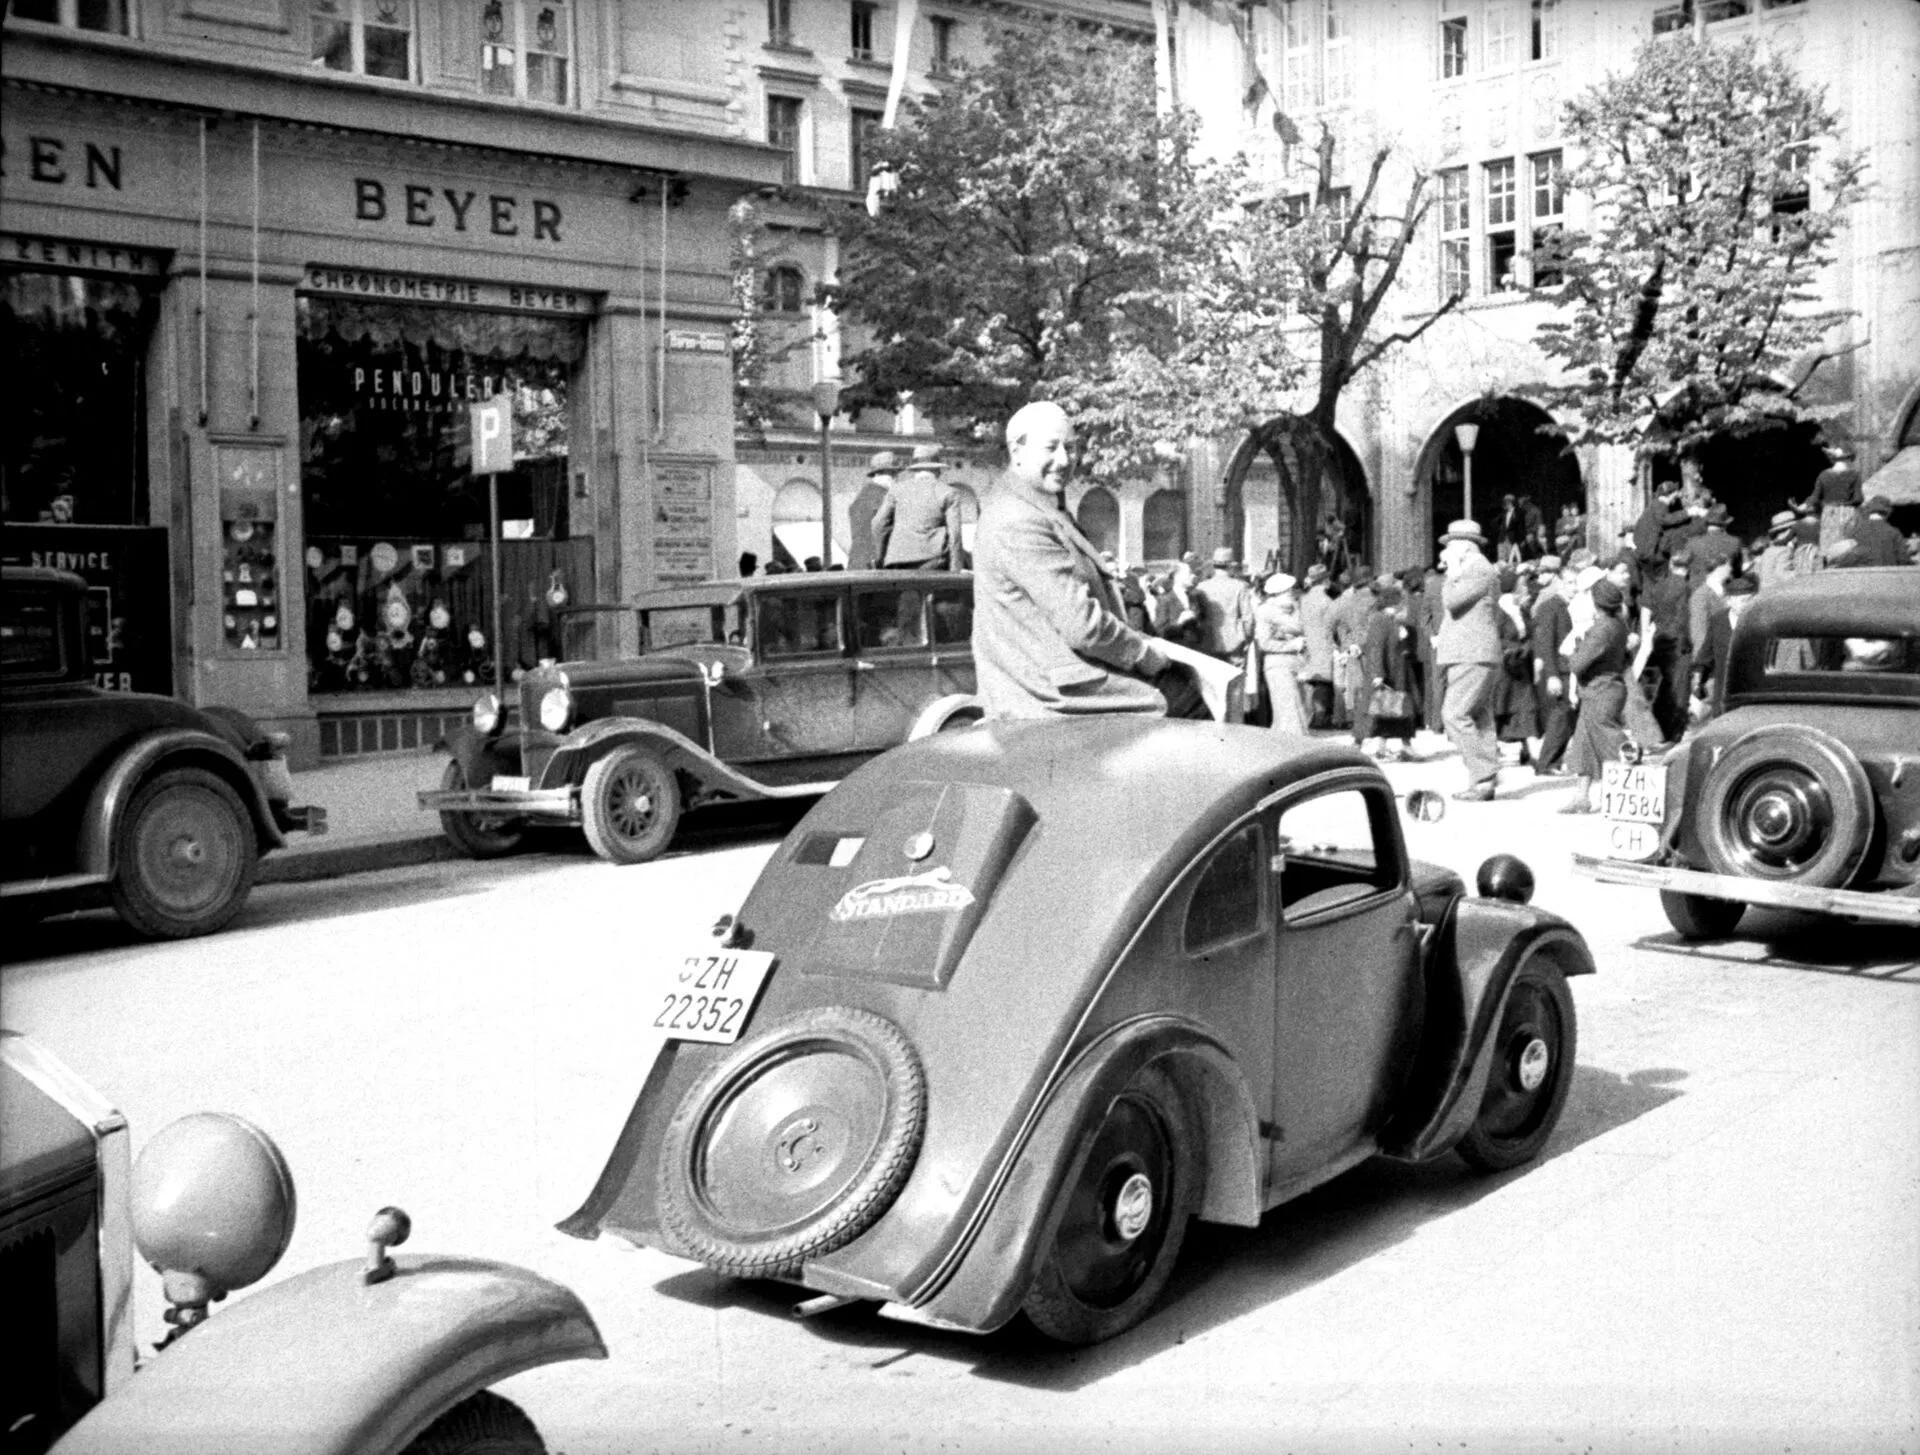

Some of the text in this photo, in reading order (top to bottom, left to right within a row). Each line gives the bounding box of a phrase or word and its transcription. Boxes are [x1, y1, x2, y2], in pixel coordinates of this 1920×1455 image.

[0, 134, 122, 190] EN
[354, 177, 562, 241] BEYER
[310, 269, 578, 311] CHRONOMETRIE BEYER
[481, 406, 500, 467] P
[1623, 768, 1646, 791] ZH
[1605, 792, 1662, 818] 17584
[1611, 826, 1642, 851] CH
[838, 888, 964, 920] STANDARD
[694, 956, 738, 991] ZH
[652, 994, 744, 1034] 22352
